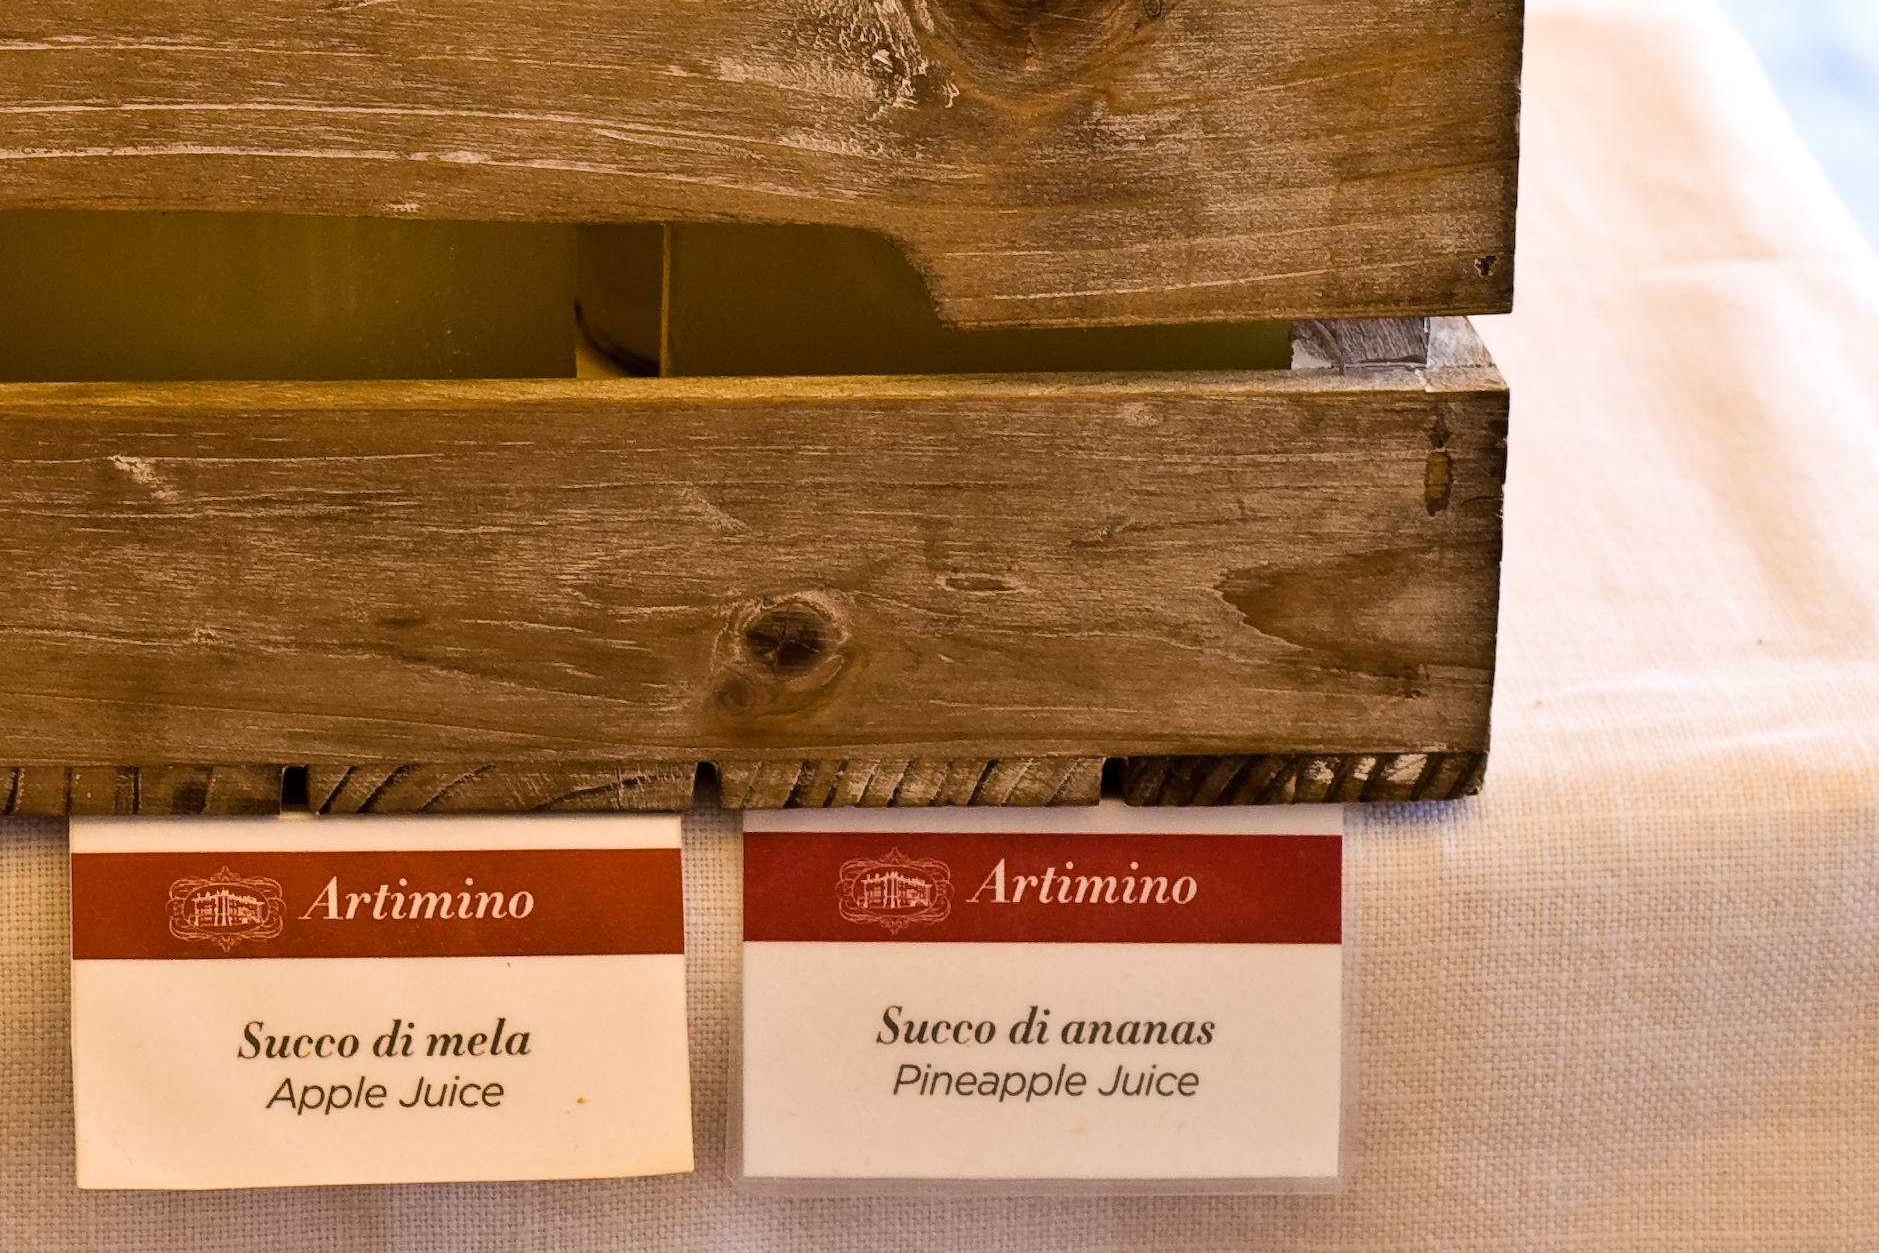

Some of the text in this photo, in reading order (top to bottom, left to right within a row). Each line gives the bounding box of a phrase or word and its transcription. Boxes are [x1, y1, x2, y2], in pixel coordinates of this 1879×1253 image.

[299, 875, 535, 922] Artimino
[965, 858, 1198, 906] Artimino
[237, 1017, 531, 1060] Succo di mela
[876, 1005, 1216, 1046] Succo di ananas
[266, 1075, 505, 1115] Apple Juice
[893, 1063, 1200, 1103] Pineapple Juice
